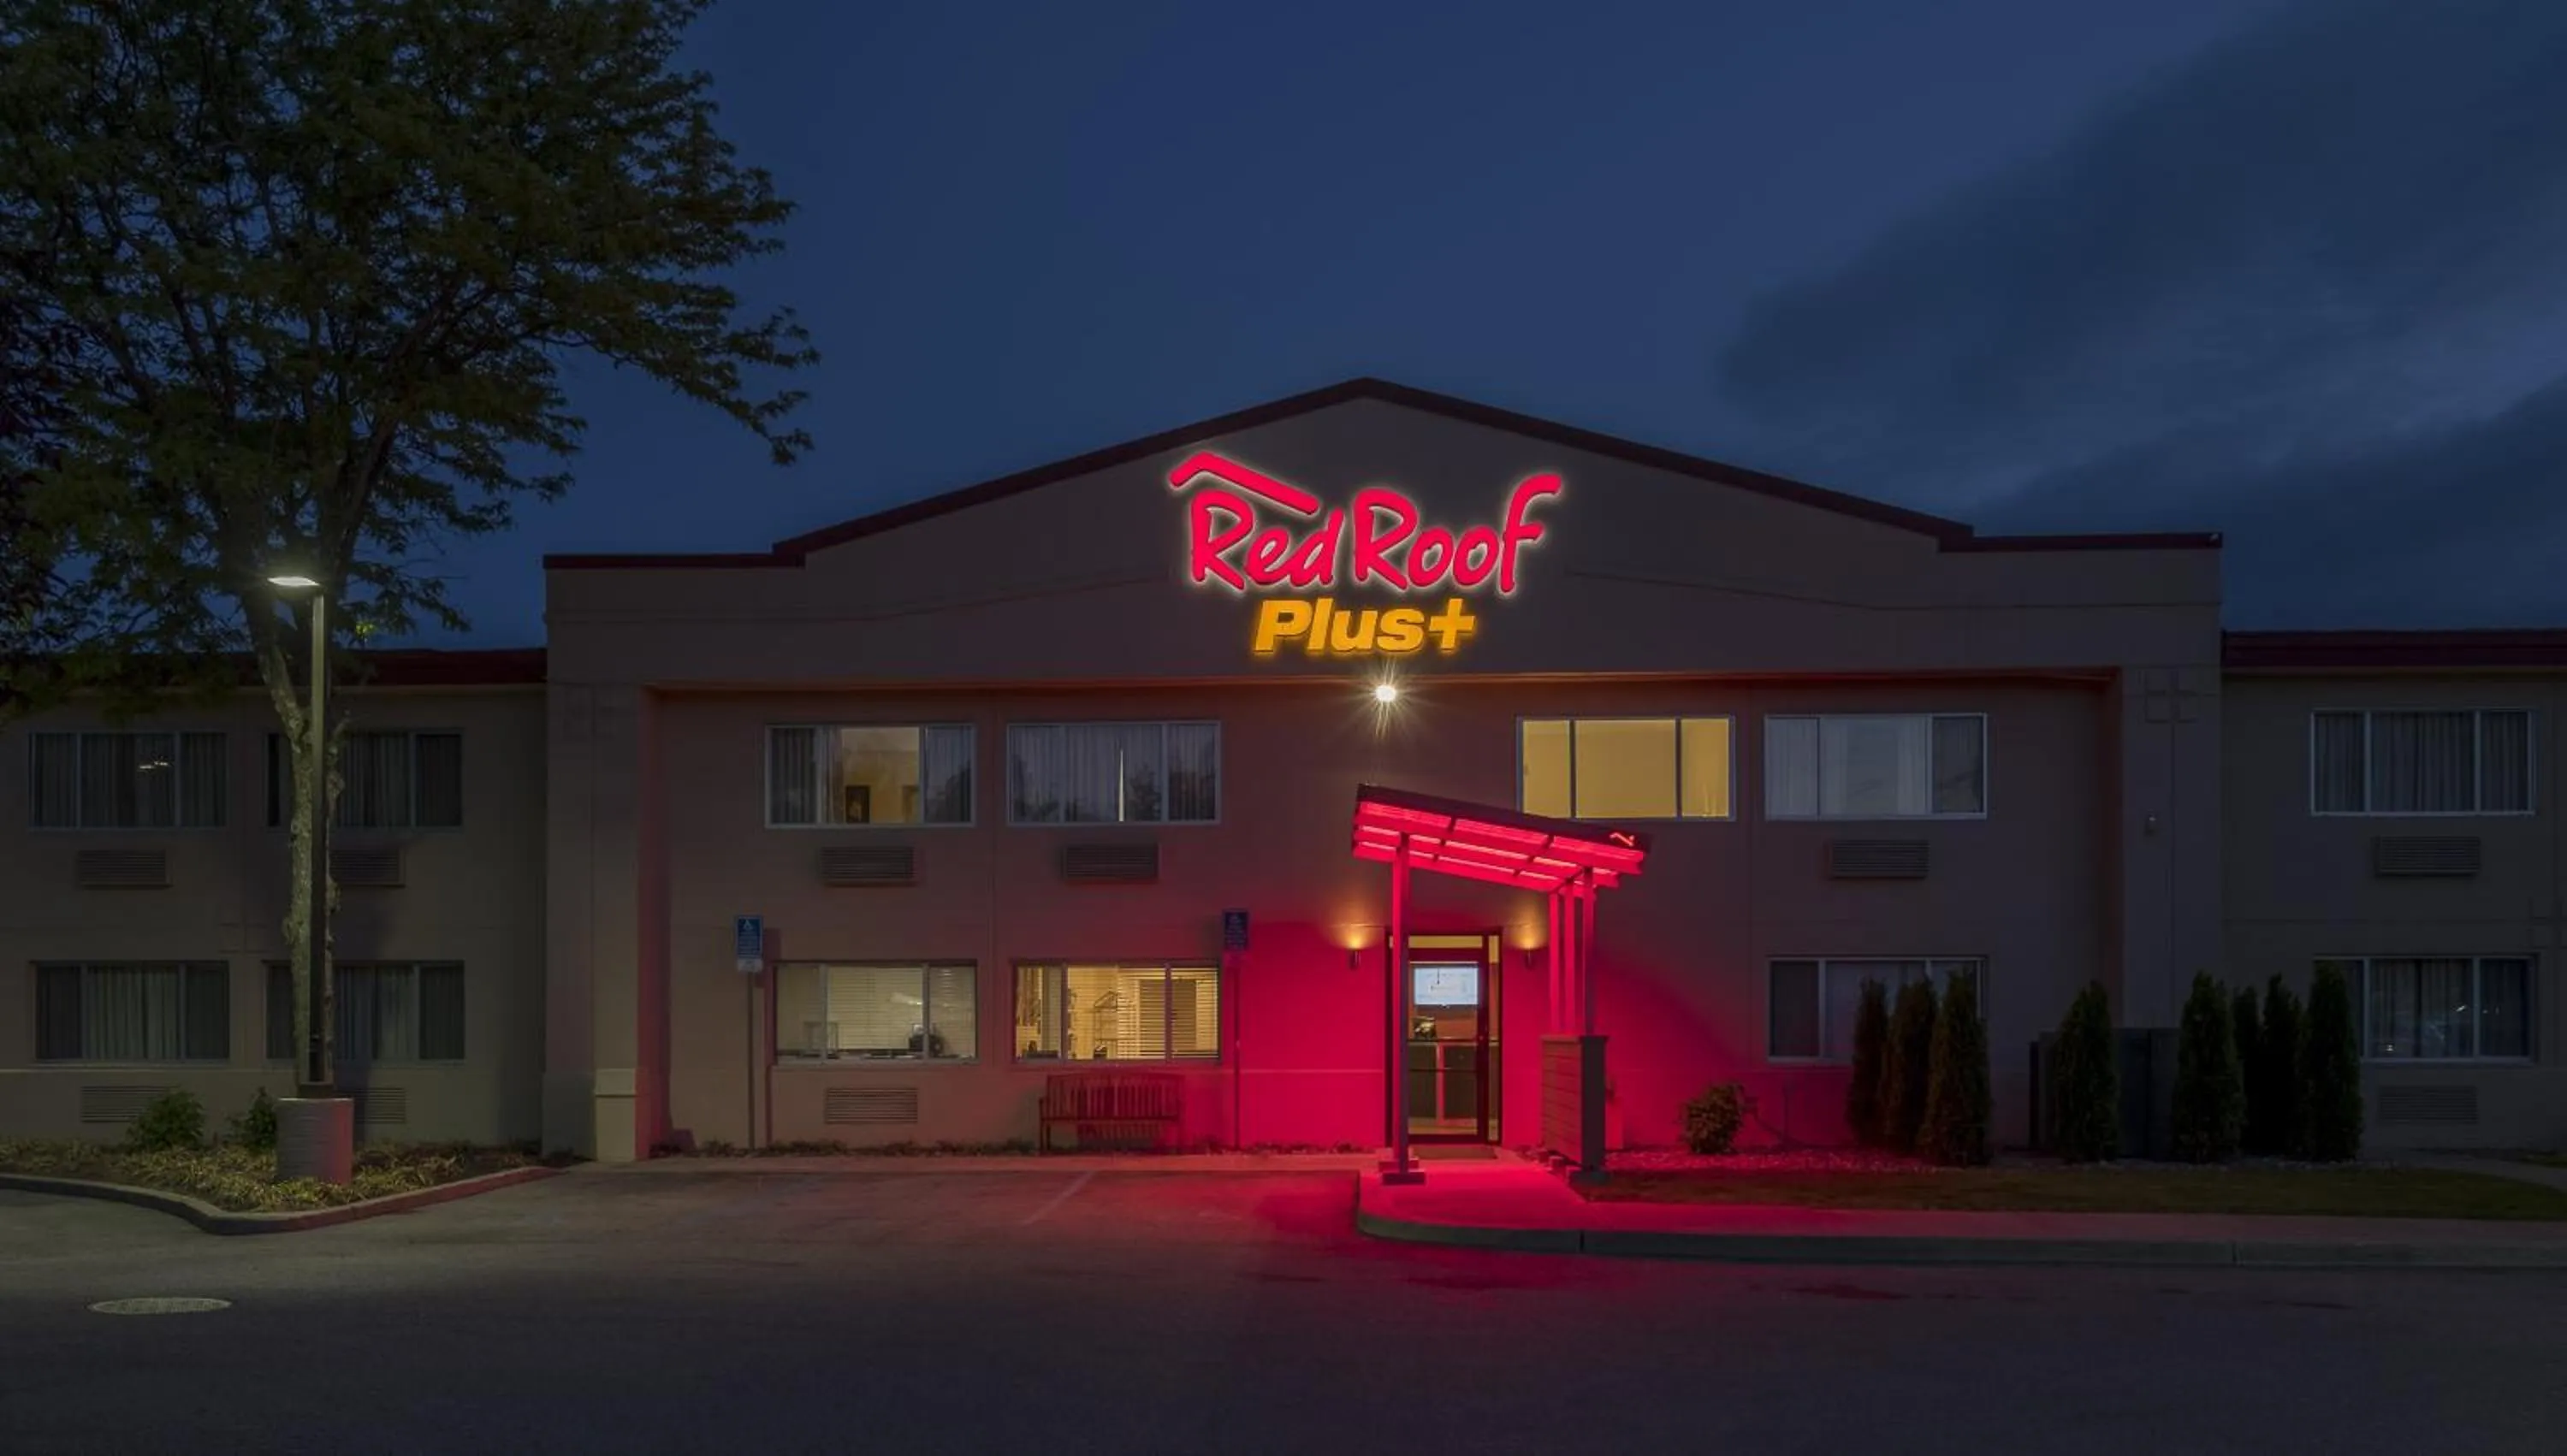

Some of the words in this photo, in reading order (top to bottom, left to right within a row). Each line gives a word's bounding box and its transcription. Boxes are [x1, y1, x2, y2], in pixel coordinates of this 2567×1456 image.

[1191, 488, 1344, 591] Red
[1353, 473, 1562, 593] Roof
[1254, 598, 1475, 653] Plus+
